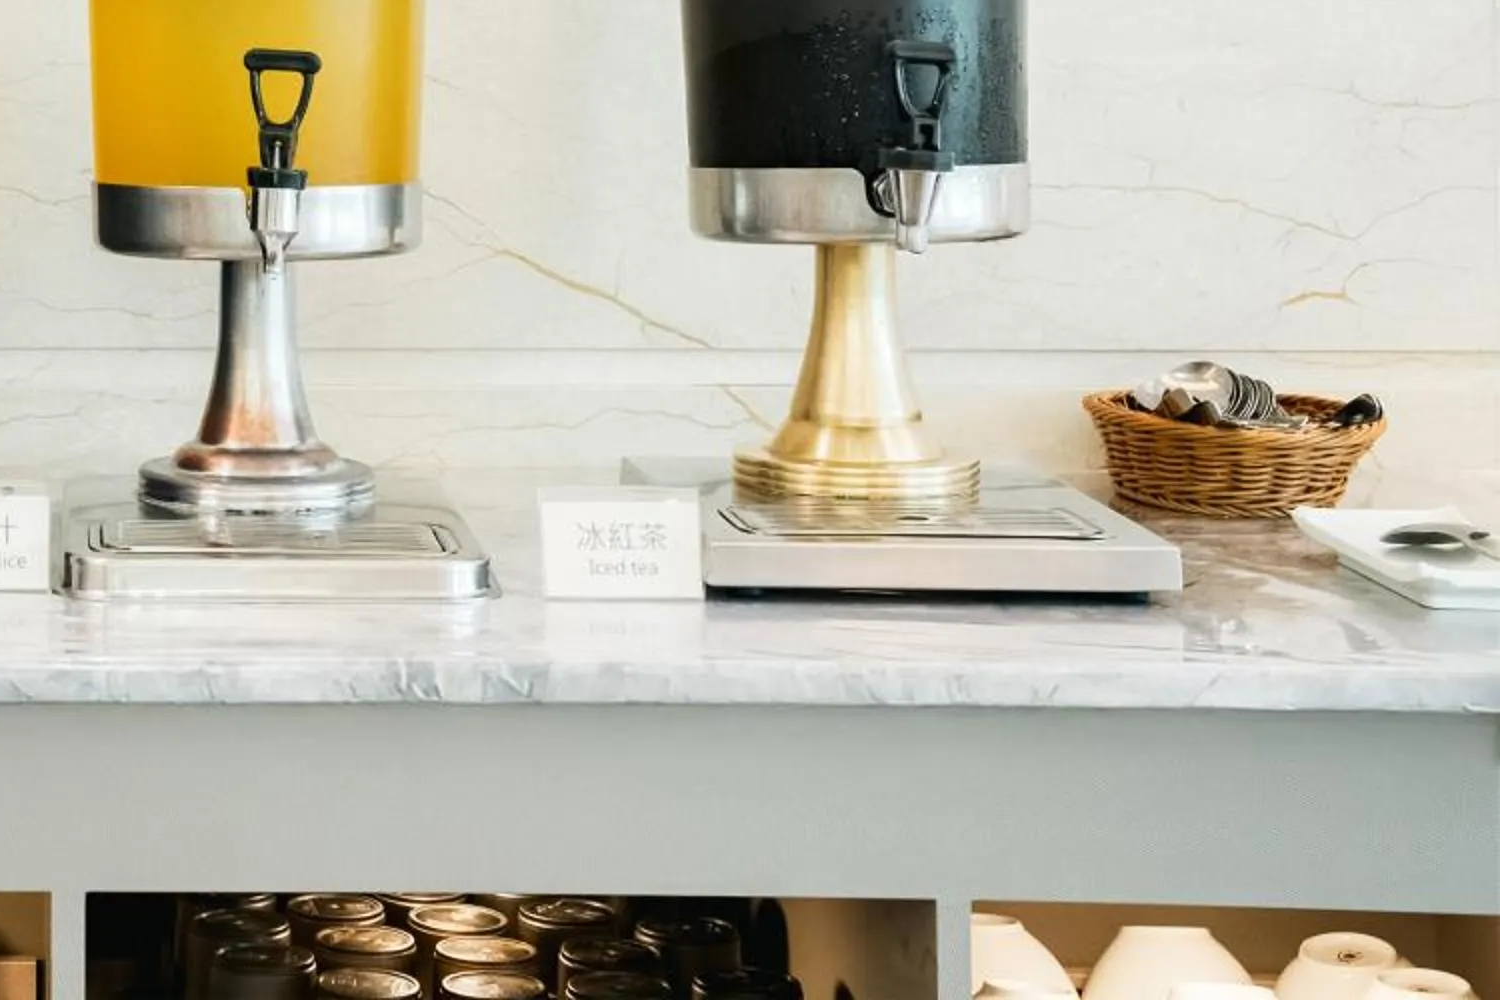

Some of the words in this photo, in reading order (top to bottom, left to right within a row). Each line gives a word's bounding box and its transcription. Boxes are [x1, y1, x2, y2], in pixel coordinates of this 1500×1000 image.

[576, 518, 668, 551] 冰紅茶
[588, 557, 626, 576] Iced
[631, 560, 660, 577] tea
